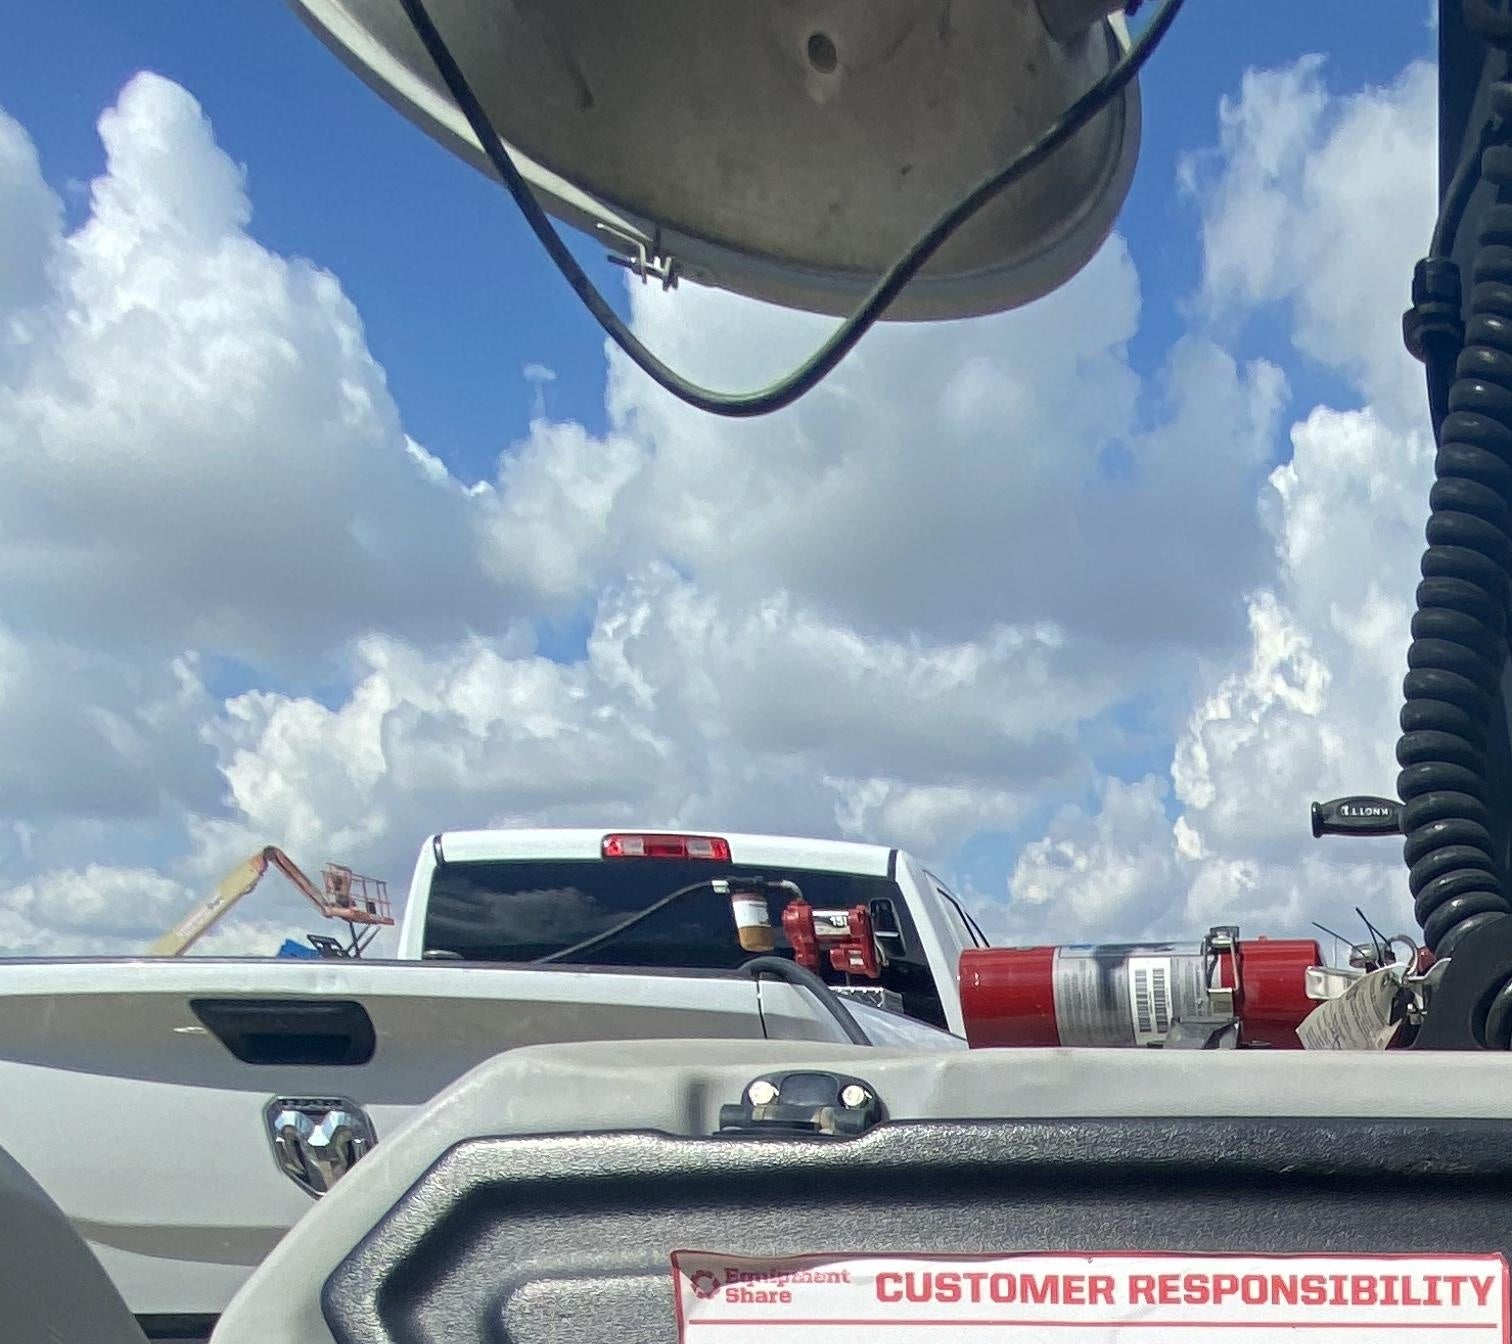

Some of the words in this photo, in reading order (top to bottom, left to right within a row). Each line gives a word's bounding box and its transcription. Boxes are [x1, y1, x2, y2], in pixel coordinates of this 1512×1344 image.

[724, 1267, 851, 1287] Equipment
[725, 1287, 792, 1303] Share
[875, 1271, 1117, 1306] CUSTOMER
[1128, 1273, 1495, 1307] RESPONSIBILITY
